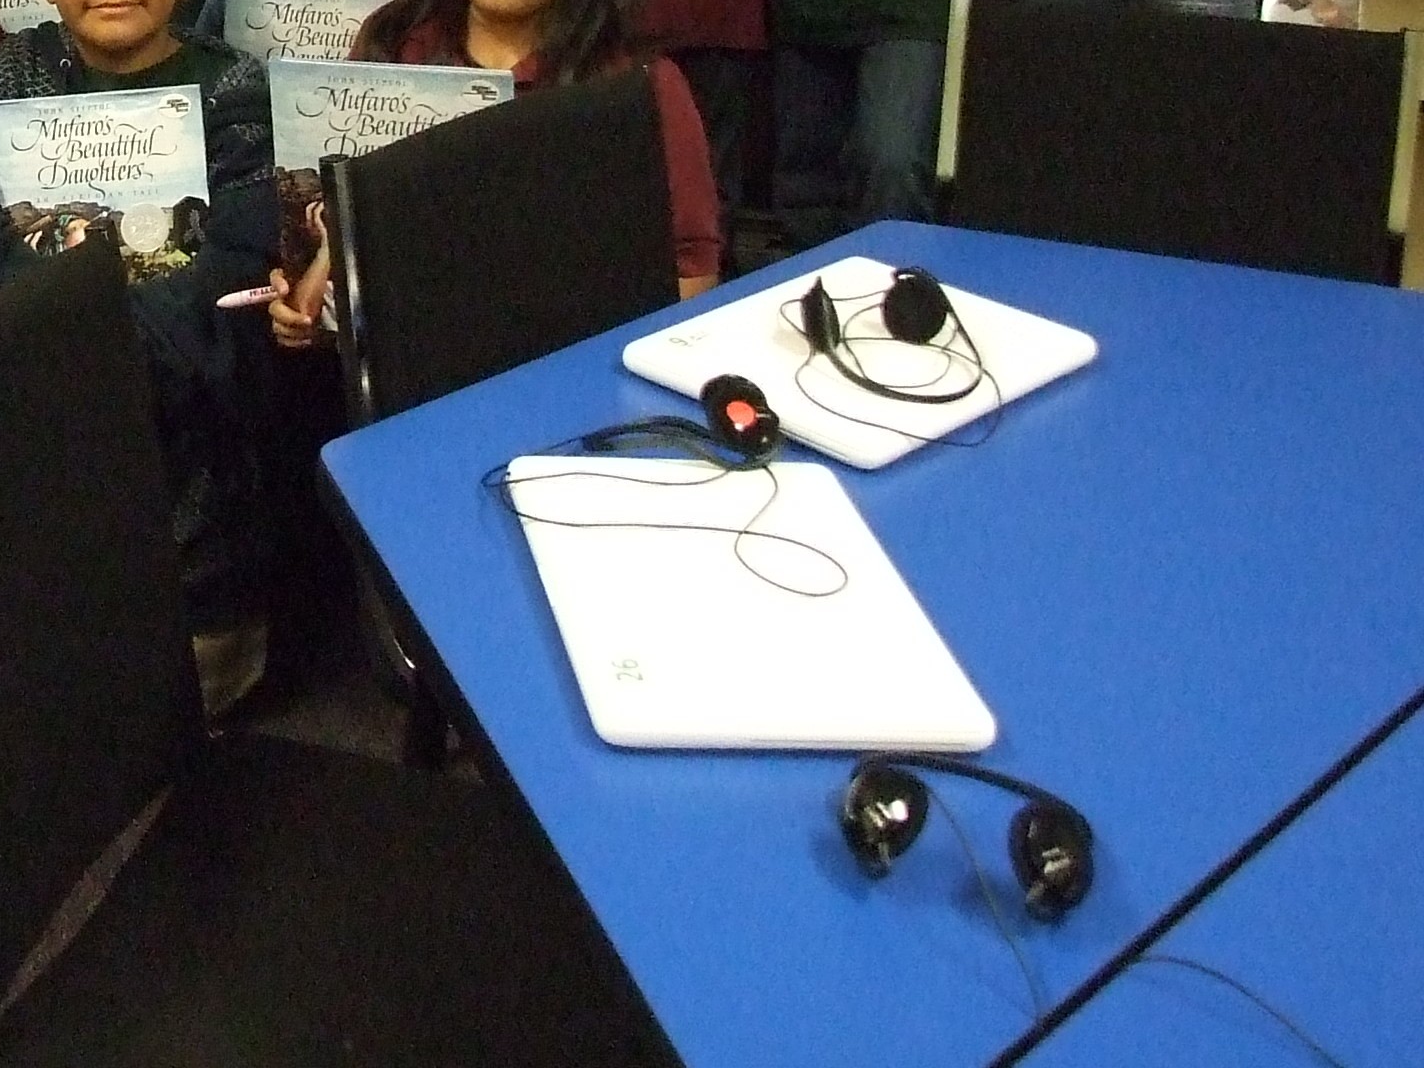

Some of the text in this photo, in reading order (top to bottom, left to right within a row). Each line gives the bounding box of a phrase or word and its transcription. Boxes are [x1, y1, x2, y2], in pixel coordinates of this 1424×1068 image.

[246, 2, 343, 29] Mufaro's
[296, 86, 412, 119] Mufaro's
[11, 115, 113, 151] Mufaro's
[41, 123, 177, 162] Beautiful
[38, 160, 153, 200] Daughters
